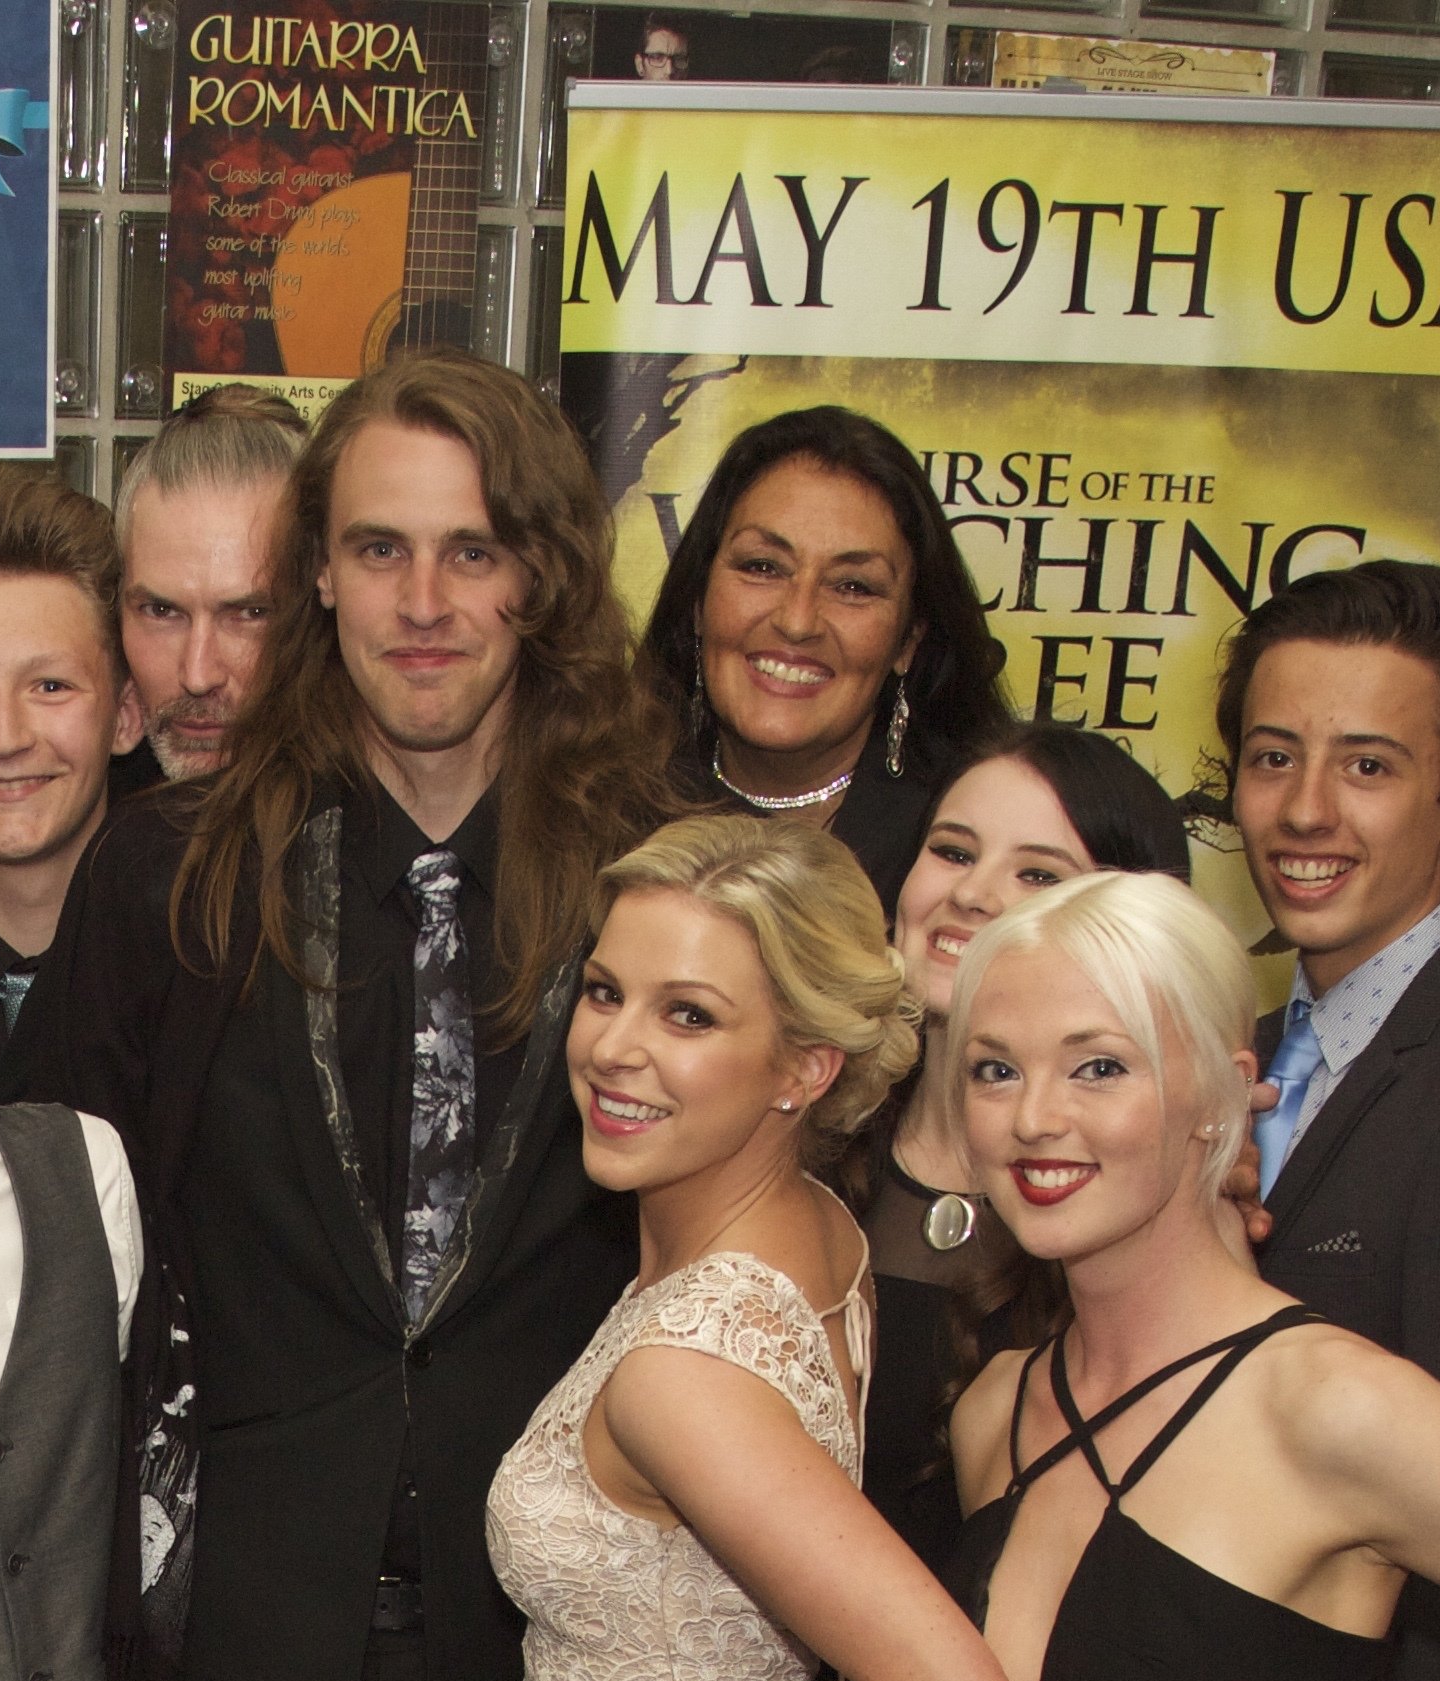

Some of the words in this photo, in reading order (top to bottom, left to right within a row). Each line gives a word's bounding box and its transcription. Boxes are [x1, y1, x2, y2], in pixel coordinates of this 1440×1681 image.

[190, 15, 426, 74] GUITARRA
[1097, 67, 1115, 77] LIVE
[189, 76, 477, 138] ROMANTICA
[209, 161, 286, 185] Classical
[287, 170, 354, 195] guitarist
[208, 195, 262, 218] Robert
[206, 235, 245, 251] some
[250, 232, 267, 258] of
[561, 169, 870, 308] MAY
[905, 176, 1224, 318] 19TH
[204, 267, 238, 285] most
[244, 266, 302, 296] uplifting
[198, 301, 249, 327] guitar
[289, 385, 315, 399] Arts
[1080, 471, 1128, 501] OF
[1139, 472, 1215, 504] THE
